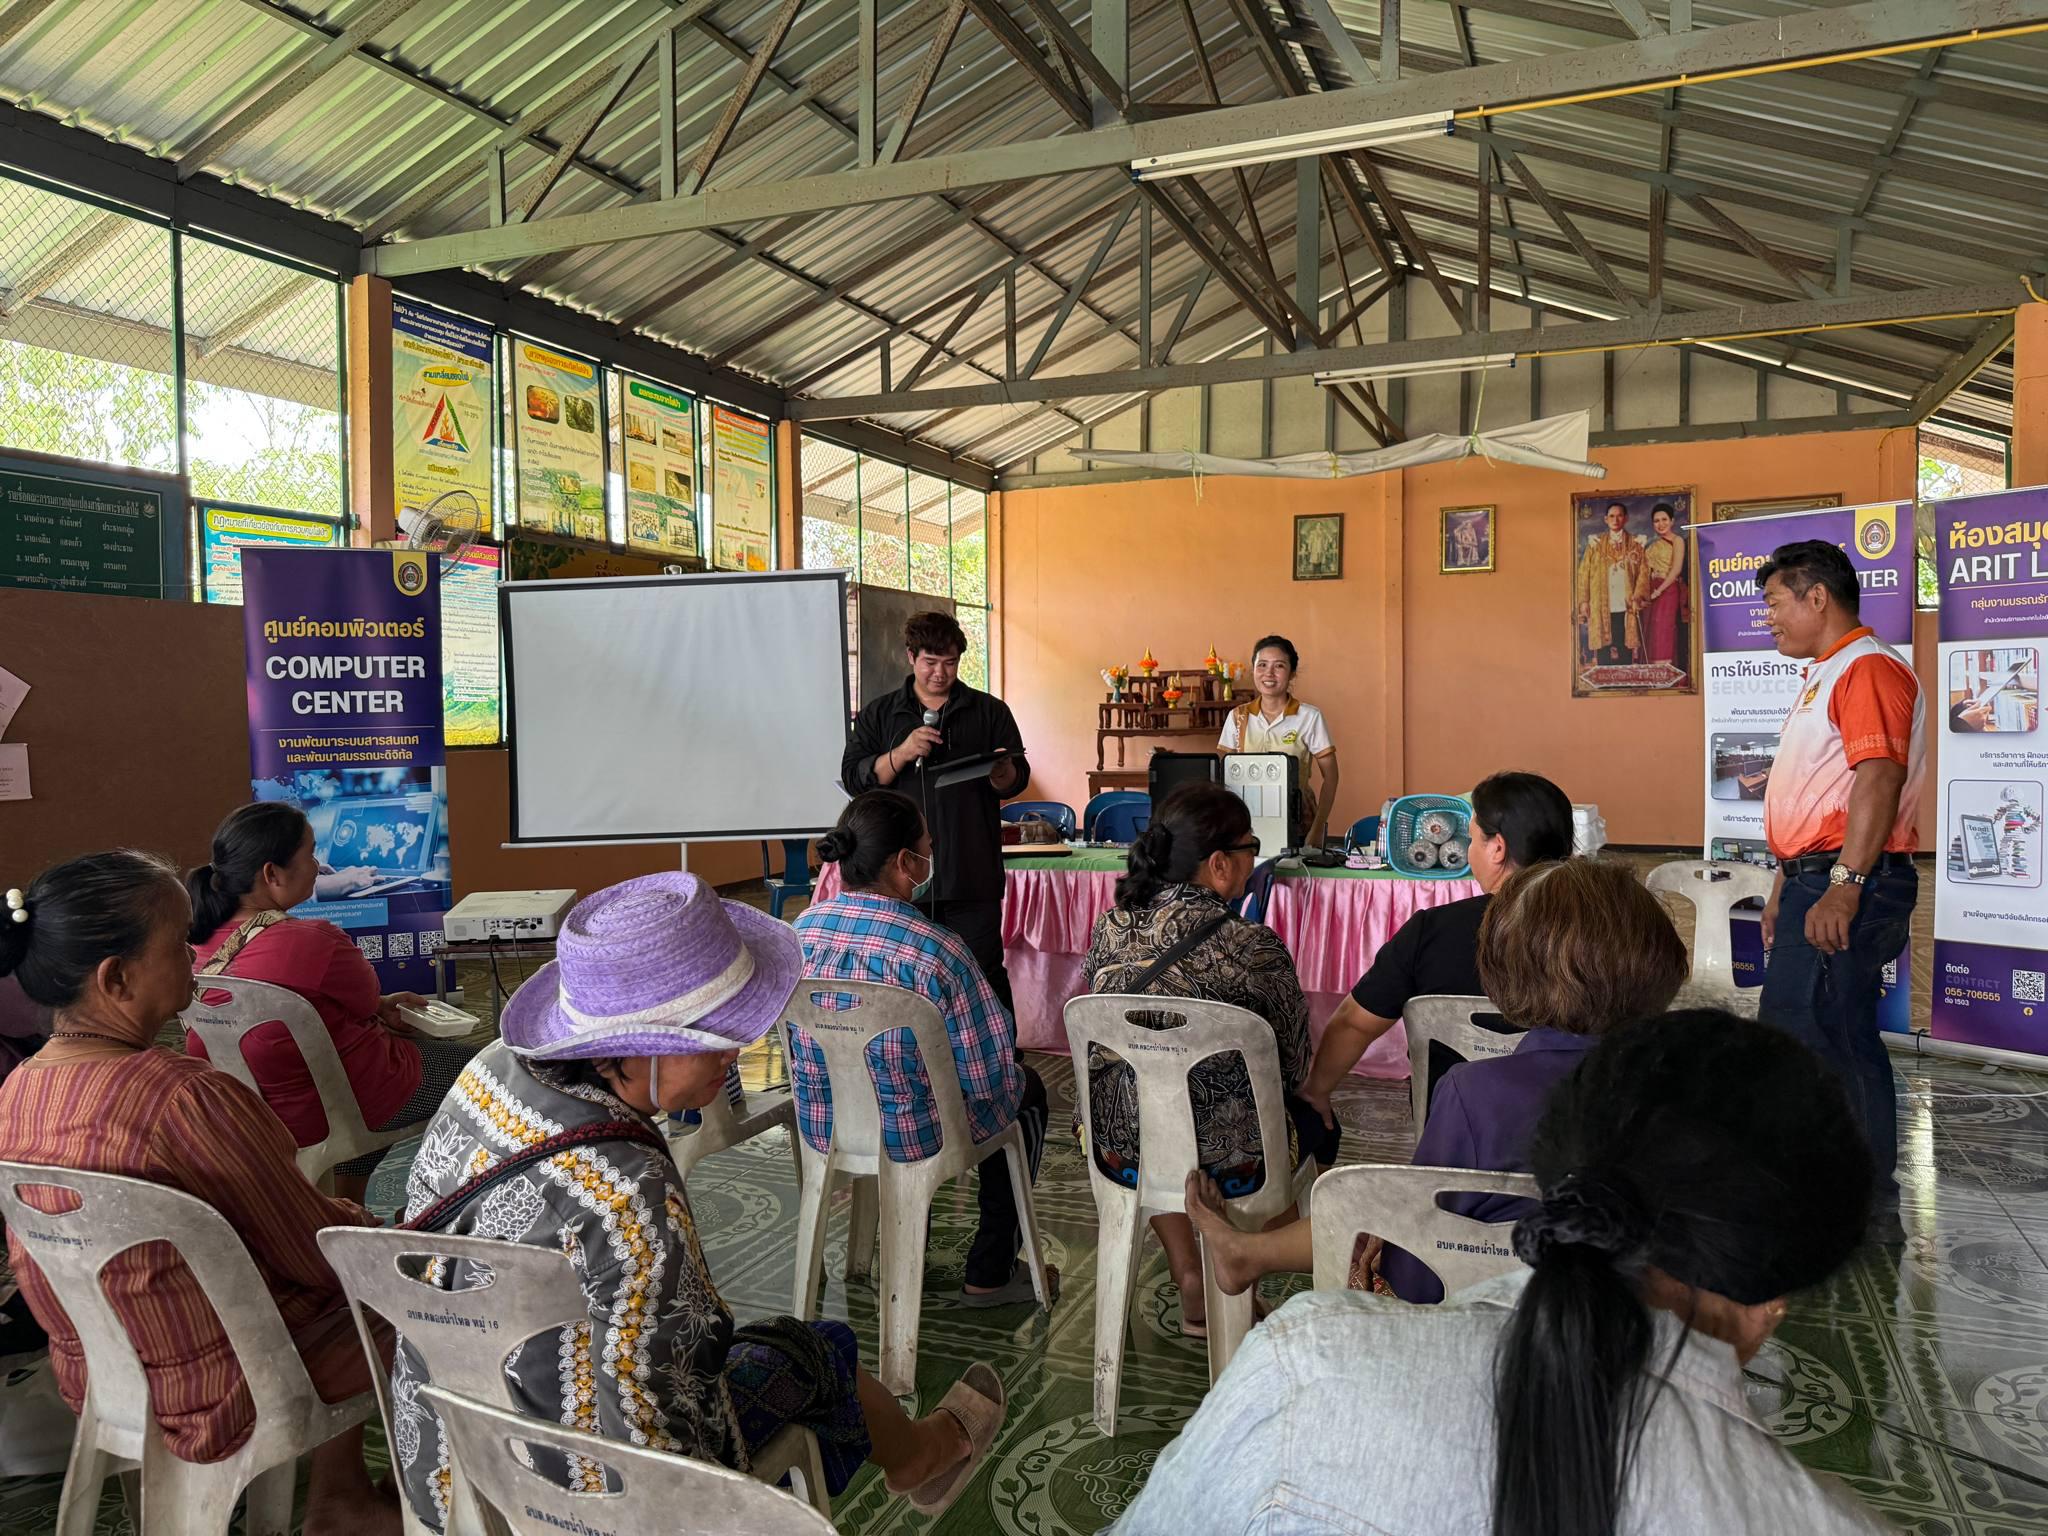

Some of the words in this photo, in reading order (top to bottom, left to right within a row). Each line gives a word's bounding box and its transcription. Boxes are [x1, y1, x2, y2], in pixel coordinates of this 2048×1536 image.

[1709, 552, 1771, 579] ศูนย์คอ
[1949, 552, 2021, 584] ARIT
[264, 616, 425, 643] ศูนย์คอมพิวเตอร์
[265, 656, 426, 679] COMPUTER
[1711, 660, 1798, 678] การให้บริการ
[1711, 679, 1798, 695] SERVICE
[292, 690, 404, 714] CENTER
[279, 735, 419, 748] งานพัฒนาระบบสารสนเทศ
[287, 748, 413, 763] และพัฒนาสมรรถนะดิจิทัล
[1945, 963, 1970, 975] ติดต่อ
[1945, 975, 2000, 990] CONTACT
[1945, 987, 2001, 1002] 055-706555
[1436, 1240, 1509, 1257] อบต.คลองน้ำไหล
[406, 1308, 471, 1328] อบต.คลองน้ำไหล
[472, 1315, 486, 1333] หมู่
[488, 1320, 499, 1329] 16
